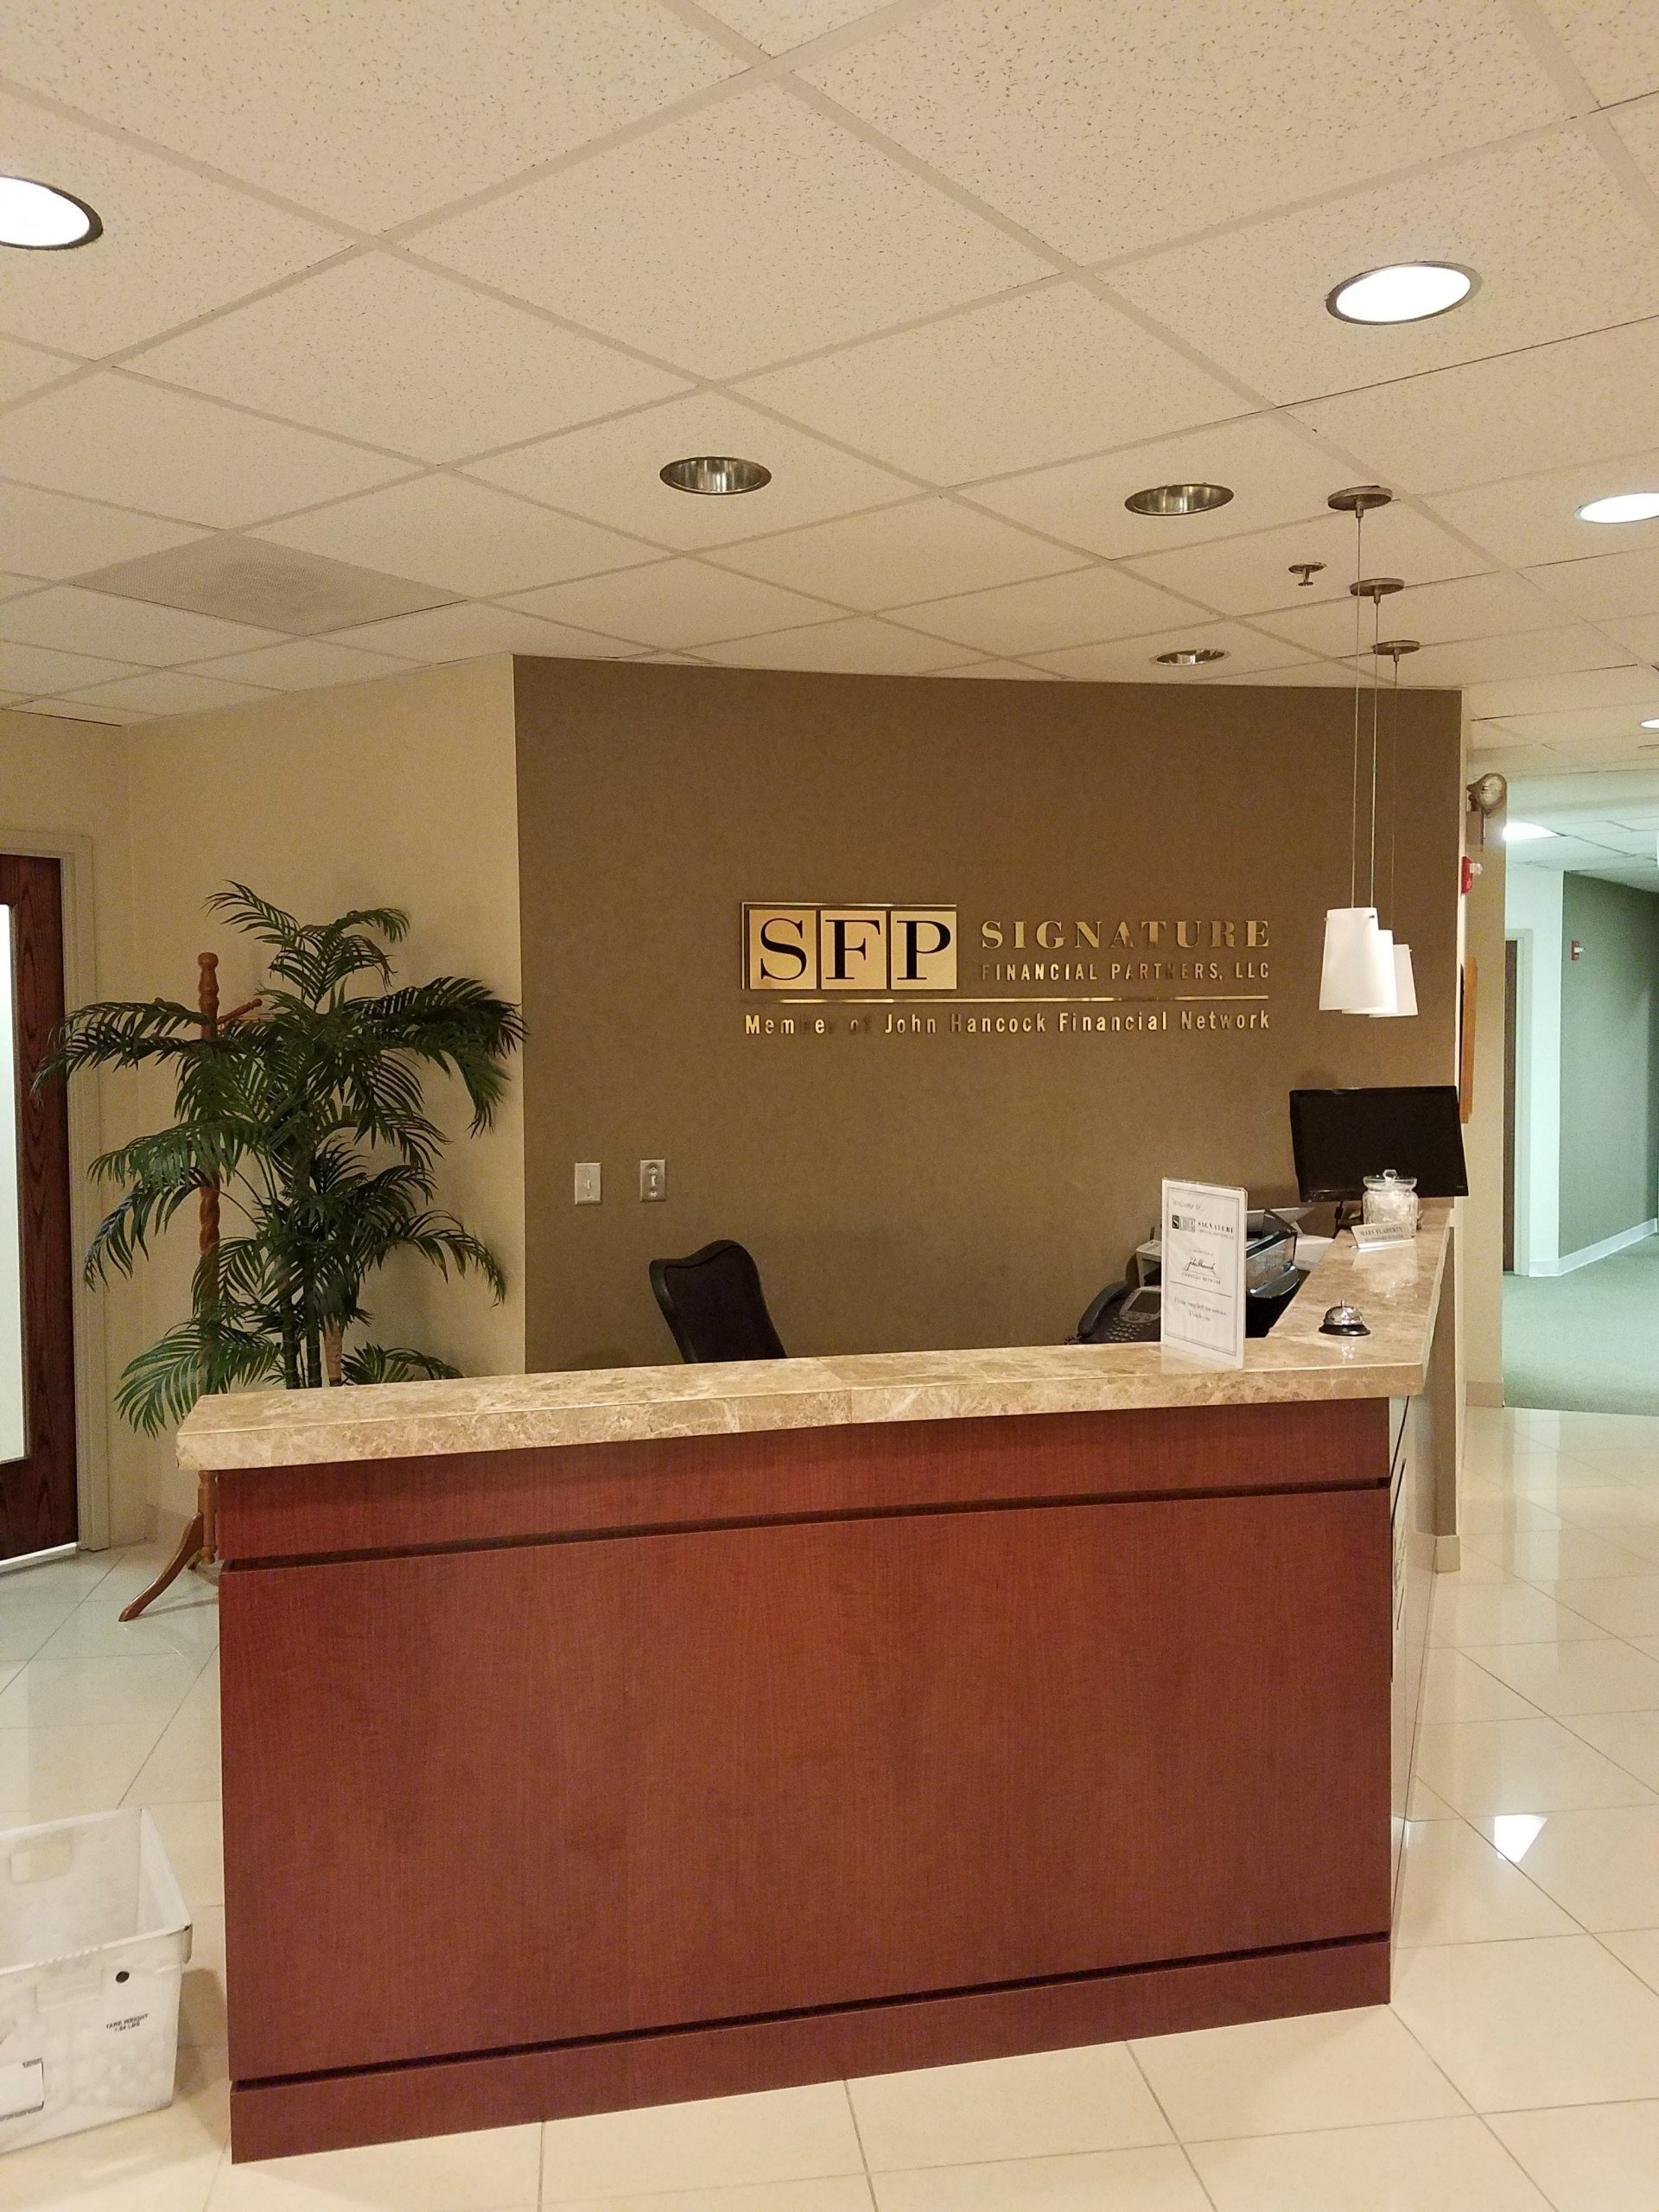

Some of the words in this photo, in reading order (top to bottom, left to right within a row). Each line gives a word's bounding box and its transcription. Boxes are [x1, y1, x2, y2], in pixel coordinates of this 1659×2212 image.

[981, 920, 1270, 950] SIGNATURE
[760, 917, 952, 982] SFP
[981, 963, 1097, 982] FINANCIAL
[1235, 961, 1270, 979] LLC
[744, 1014, 836, 1035] Meme
[884, 1013, 938, 1034] John
[950, 1012, 1046, 1033] Hancock
[1058, 1010, 1167, 1032] Financial
[1180, 1008, 1270, 1030] Network
